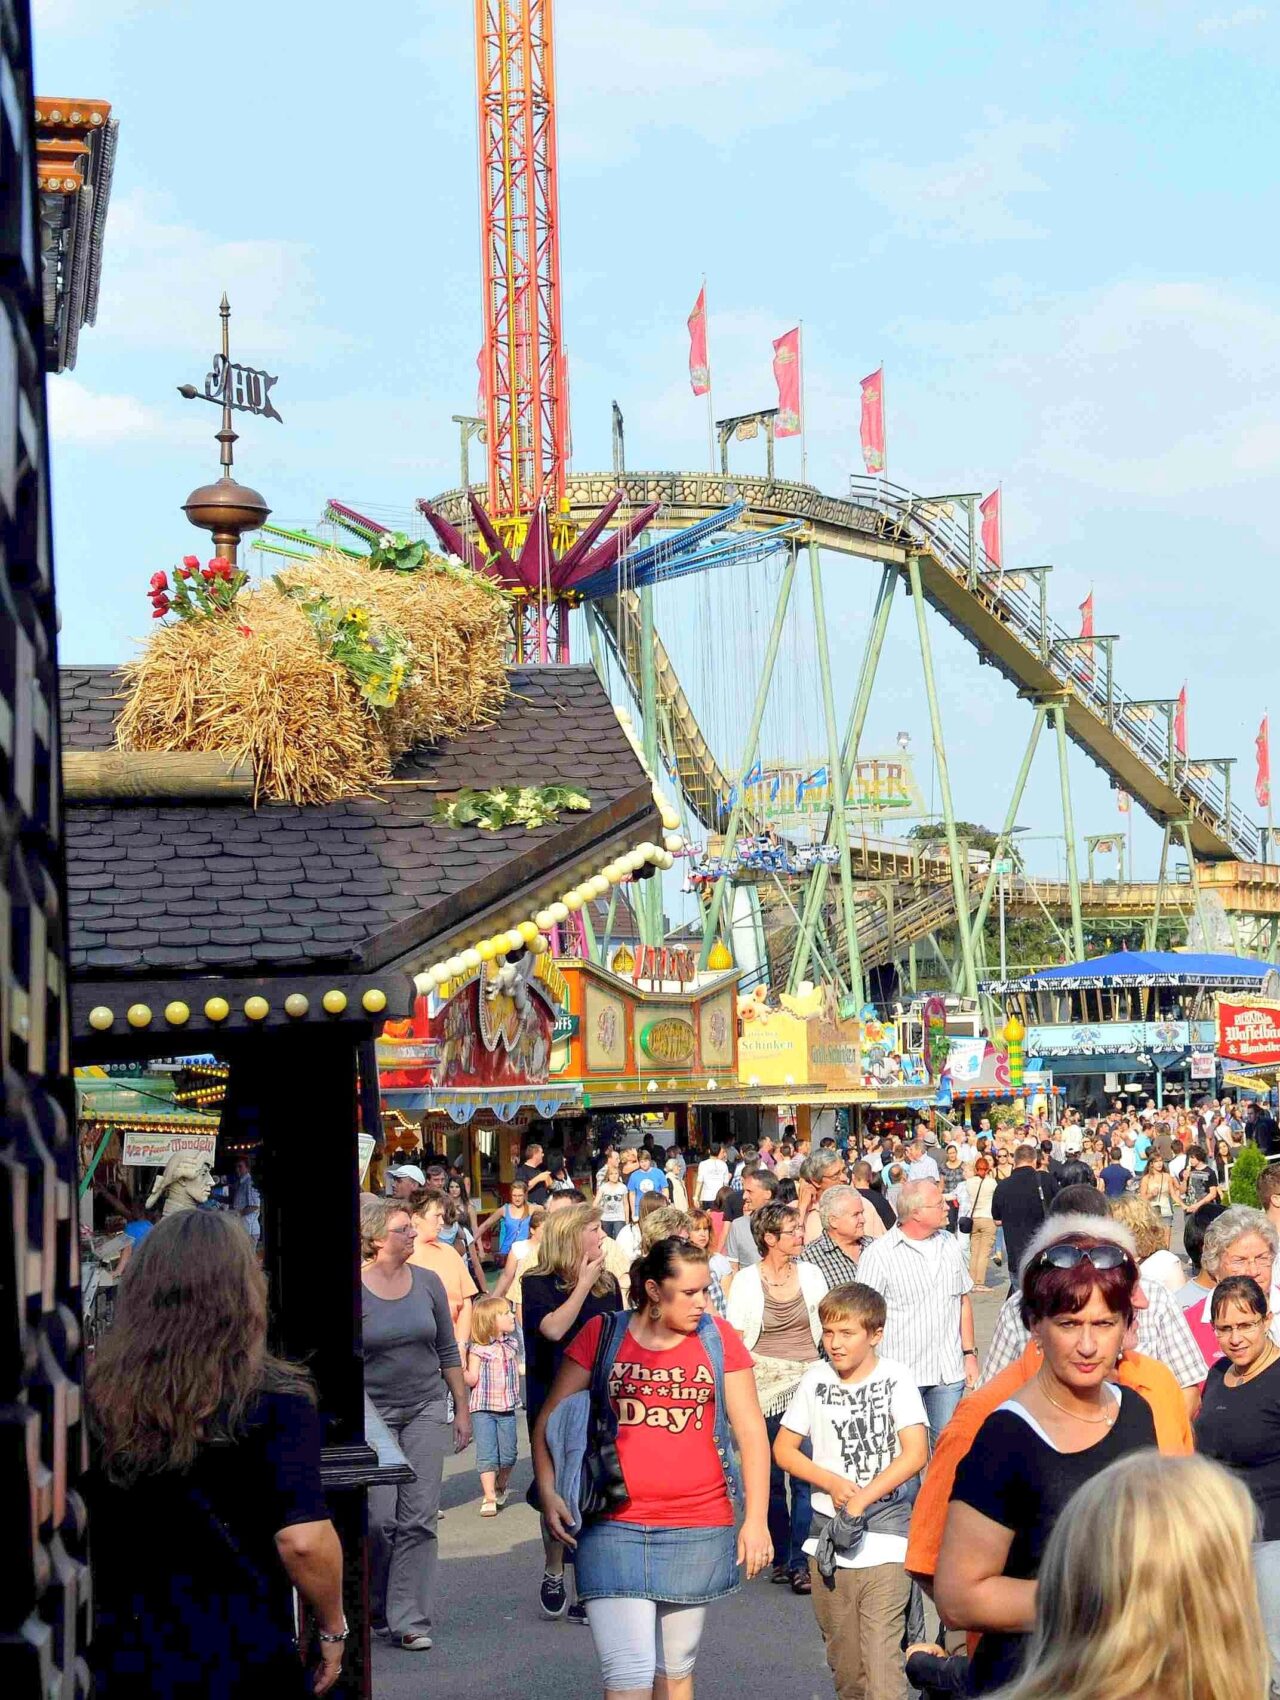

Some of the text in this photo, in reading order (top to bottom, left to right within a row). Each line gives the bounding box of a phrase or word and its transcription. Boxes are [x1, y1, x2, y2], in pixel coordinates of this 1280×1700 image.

[609, 1362, 715, 1385] What A
[616, 1397, 705, 1434] Day!
